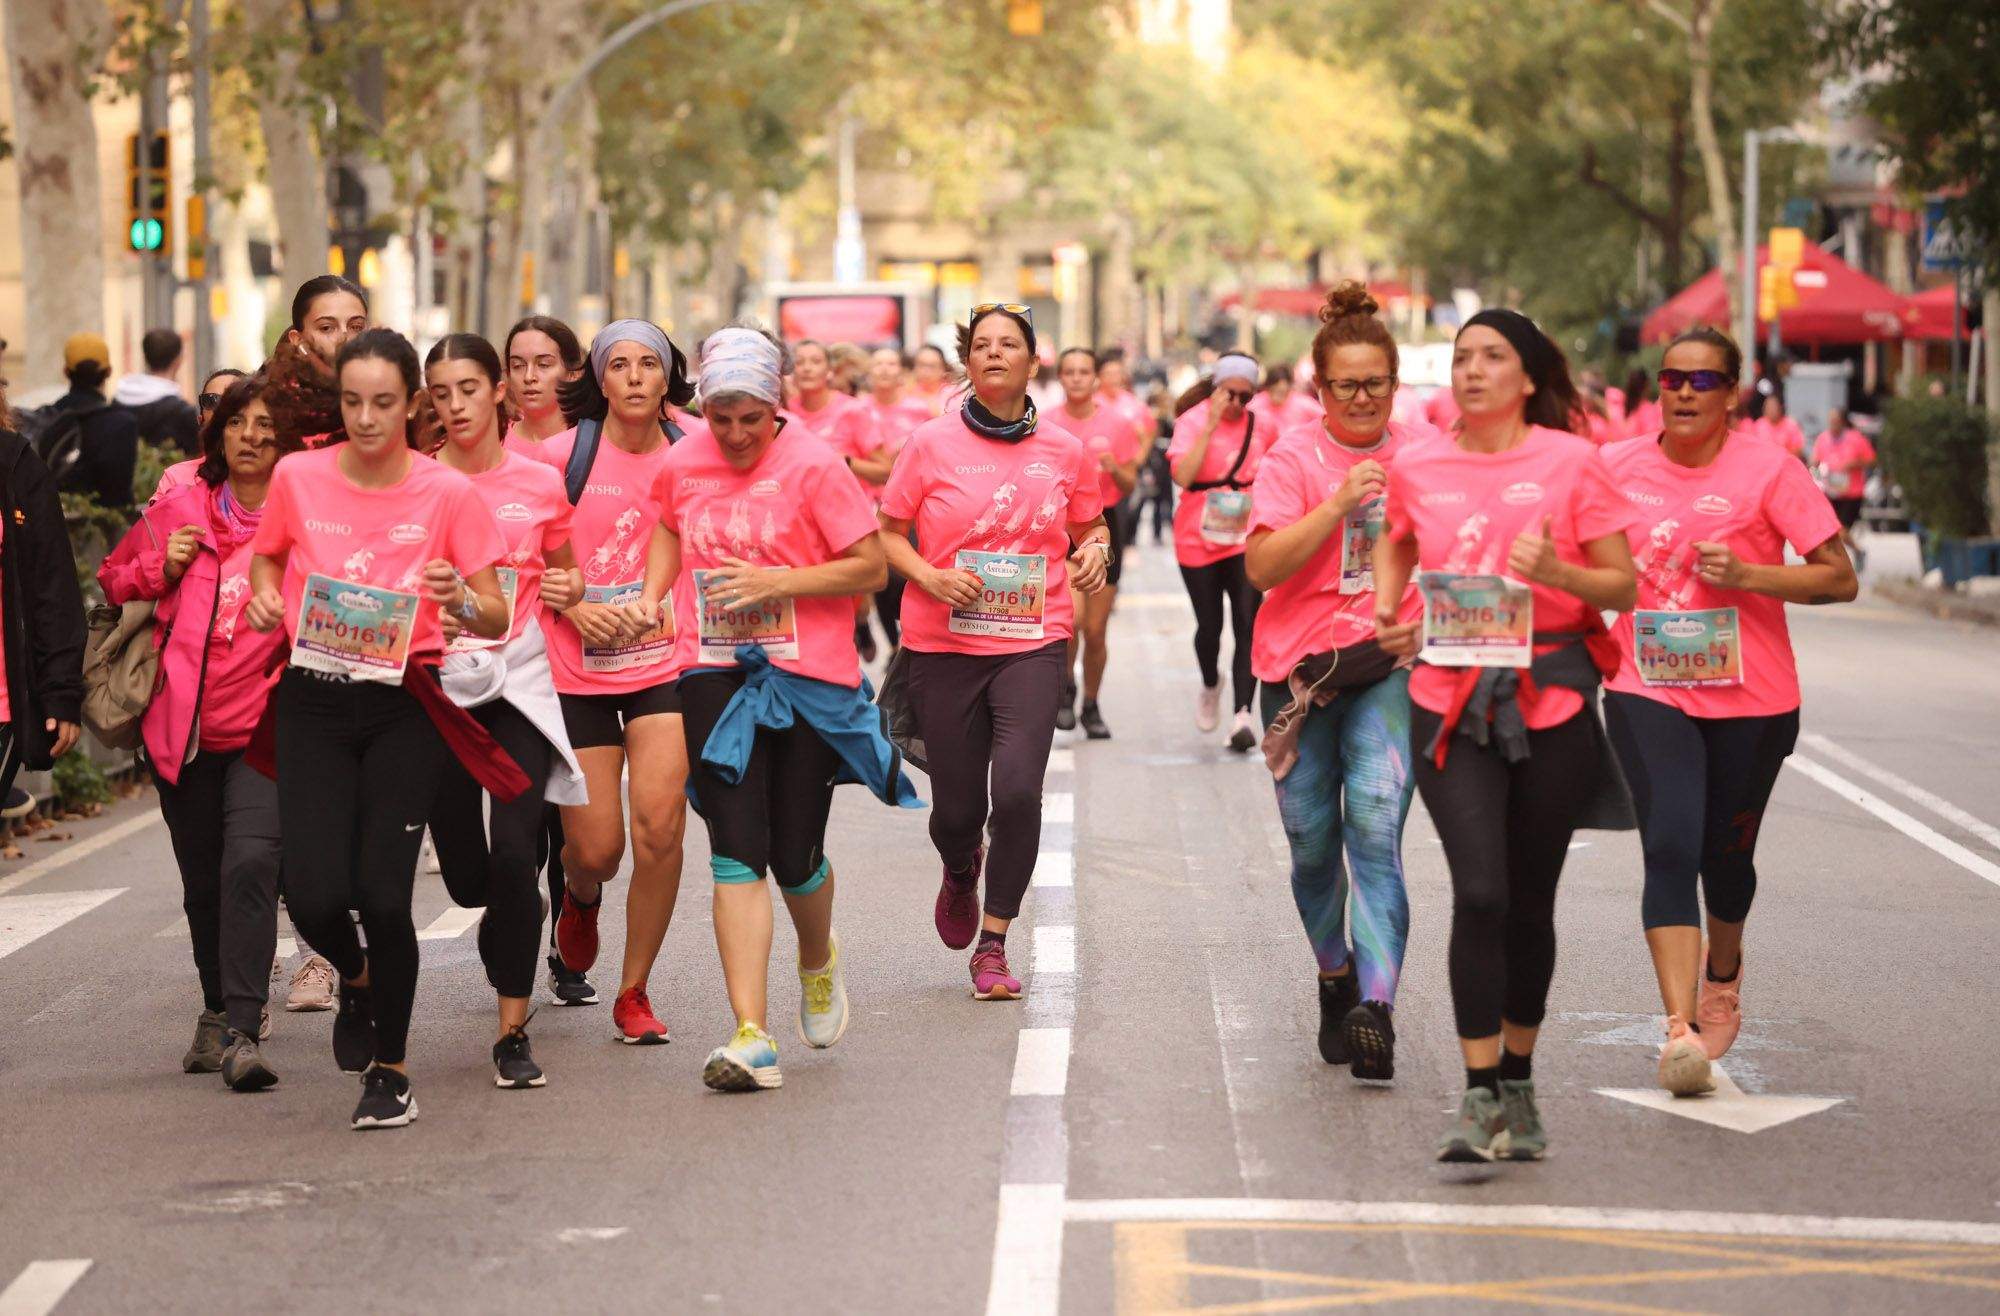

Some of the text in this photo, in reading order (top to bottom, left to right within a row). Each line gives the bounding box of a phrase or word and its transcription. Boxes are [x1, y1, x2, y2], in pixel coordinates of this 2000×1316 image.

[955, 464, 996, 475] OYSHO
[682, 477, 720, 490] OYSHO
[305, 519, 352, 536] OYSHO
[983, 589, 1019, 605] 016
[727, 610, 762, 626] 016
[1457, 606, 1494, 623] 016
[335, 622, 375, 643] 016
[959, 622, 989, 630] OYSHO
[1667, 652, 1706, 668] 016
